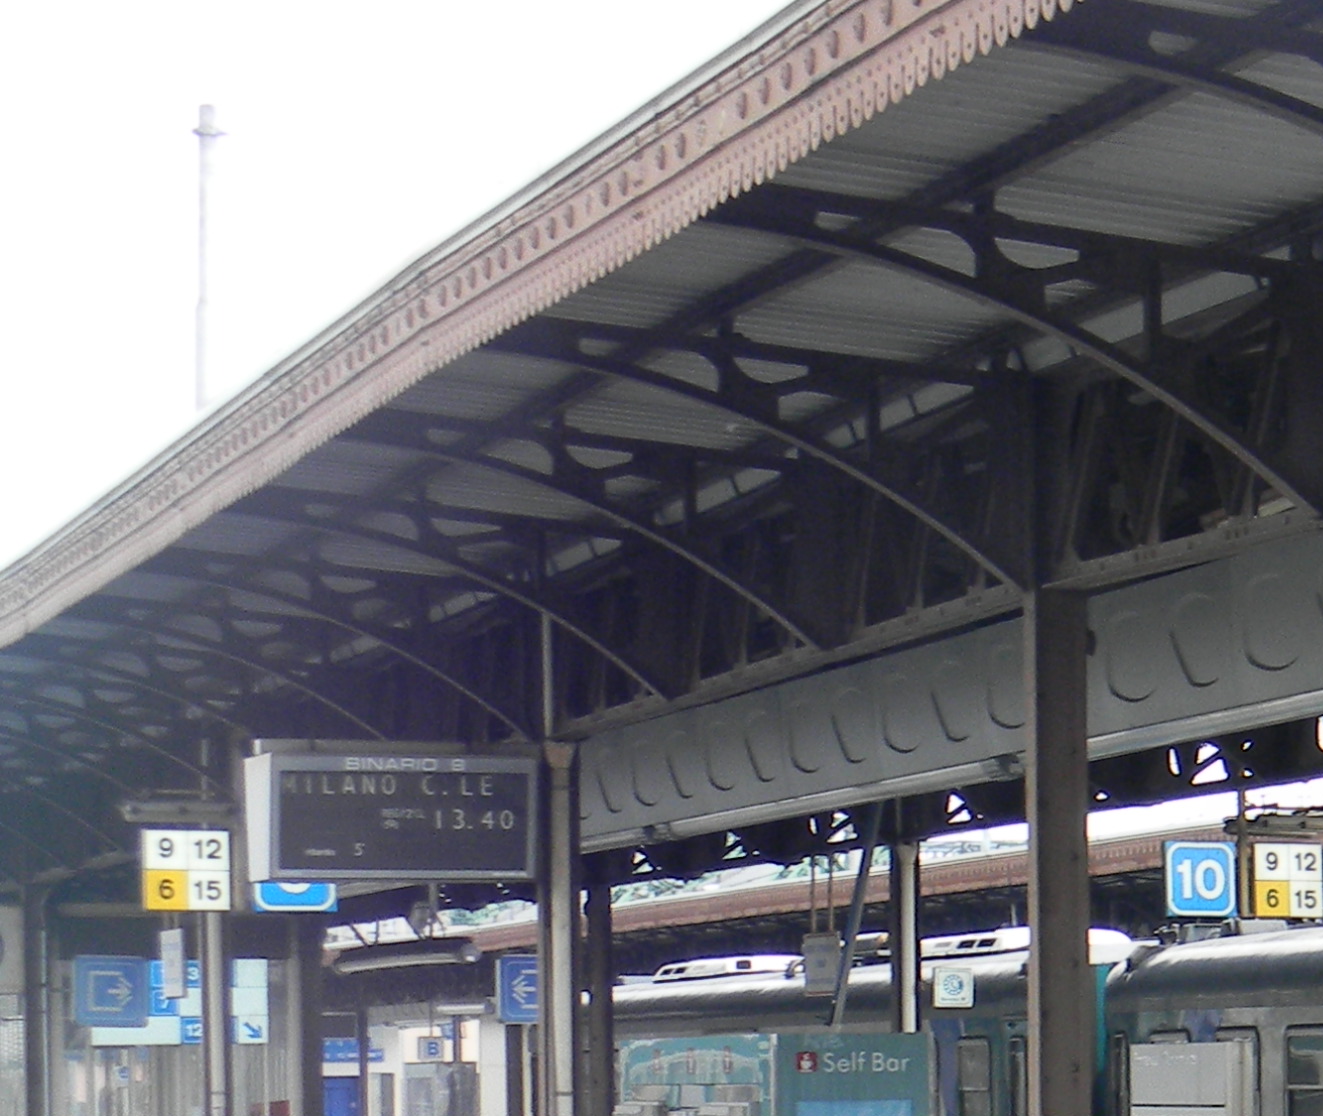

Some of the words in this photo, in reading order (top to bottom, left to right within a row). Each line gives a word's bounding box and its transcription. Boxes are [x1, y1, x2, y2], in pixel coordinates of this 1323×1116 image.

[345, 757, 438, 771] BINARIO
[283, 775, 397, 795] MILANO
[434, 809, 515, 830] 13.40
[159, 838, 174, 858] 9
[193, 838, 222, 859] 12
[1266, 852, 1279, 871] 9
[1294, 852, 1317, 871] 12
[1177, 858, 1226, 900] 10
[159, 879, 175, 900] 6
[193, 880, 222, 901] 15
[1266, 889, 1280, 908] 6
[1294, 890, 1317, 909] 15
[187, 966, 200, 980] 3
[823, 1051, 866, 1073] Self
[871, 1051, 910, 1072] Bar
